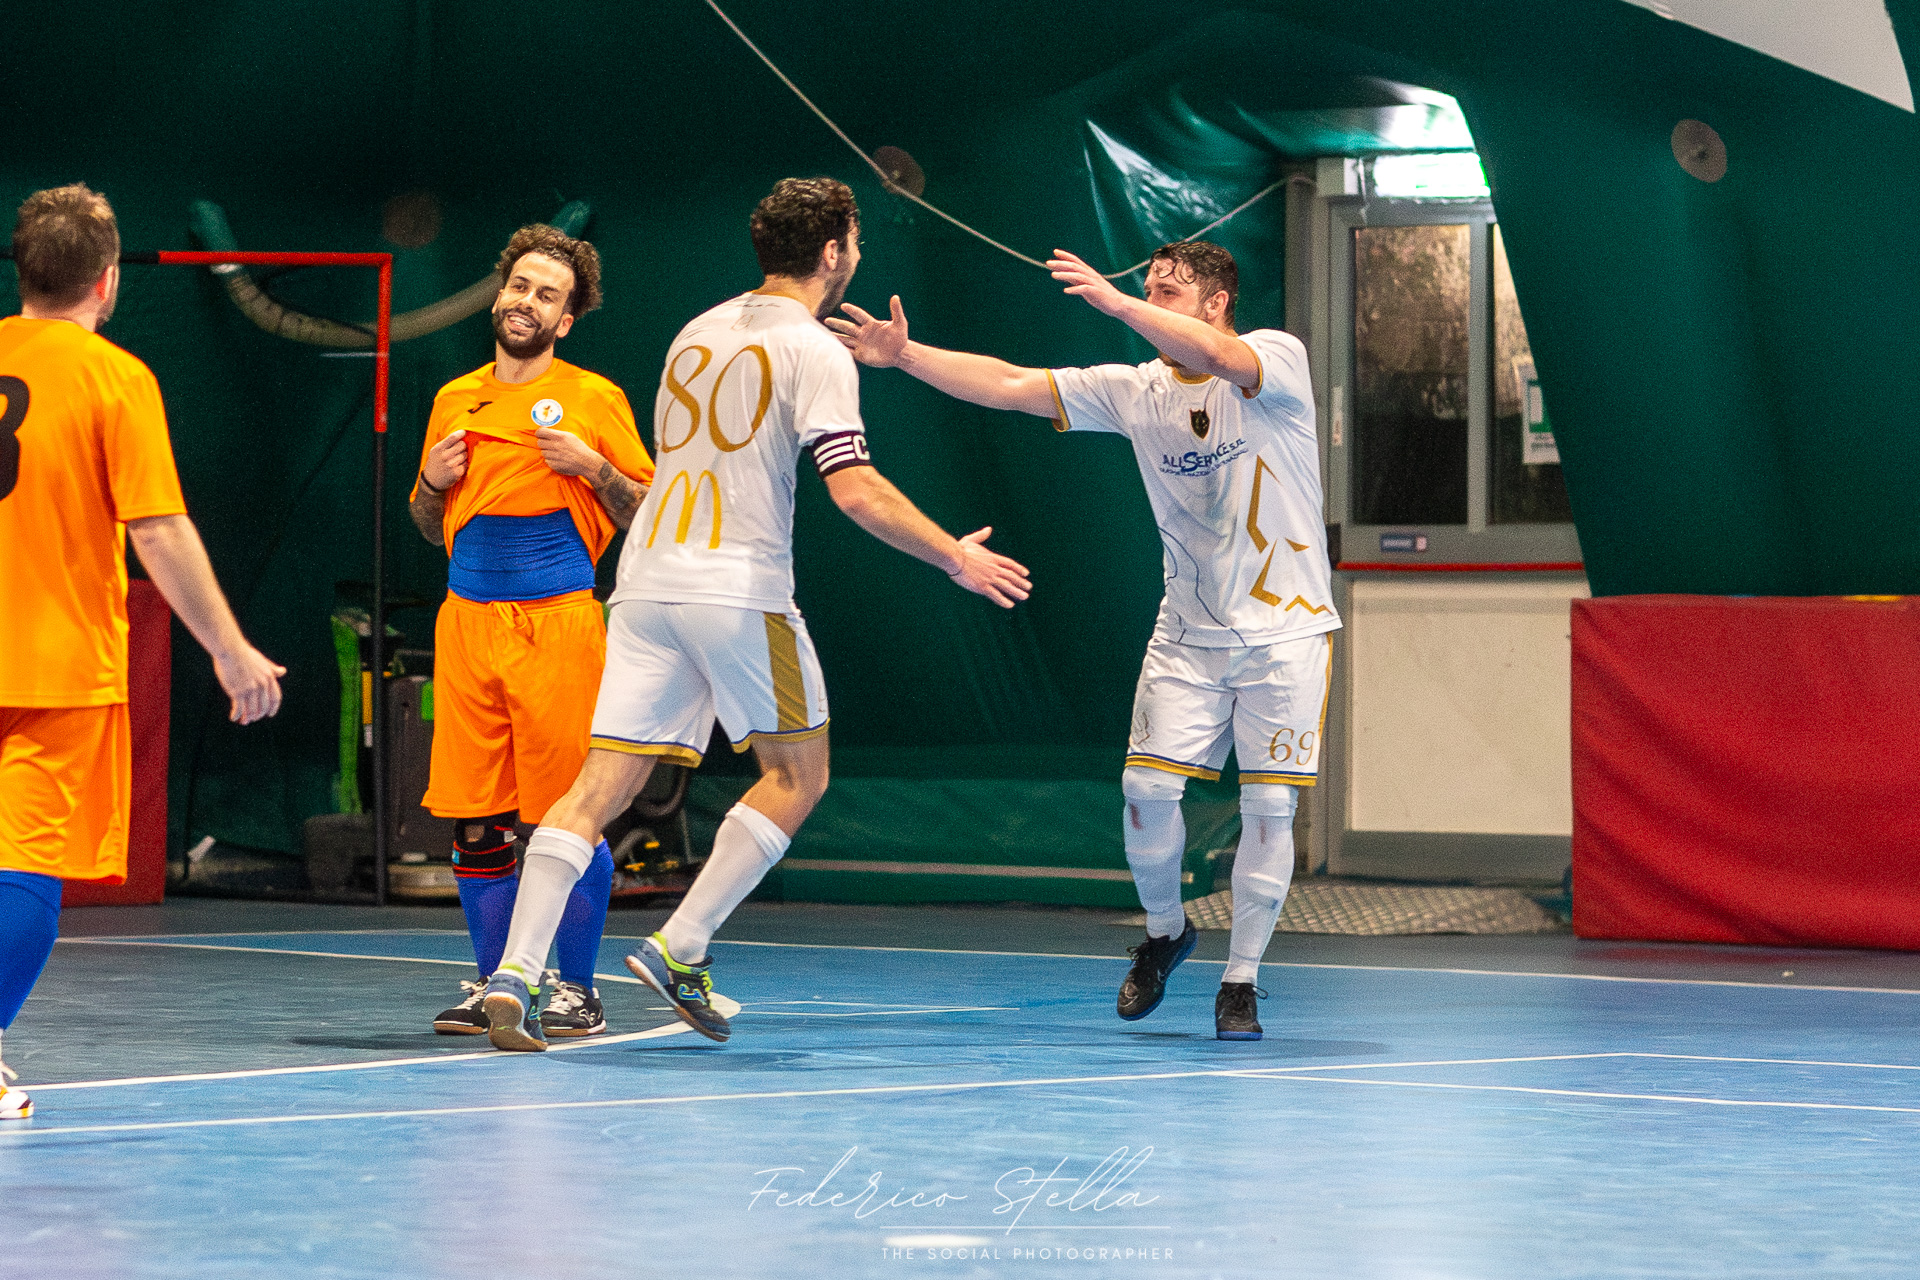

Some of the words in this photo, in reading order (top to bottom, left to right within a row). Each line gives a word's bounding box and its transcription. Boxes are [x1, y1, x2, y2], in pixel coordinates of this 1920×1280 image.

[662, 344, 773, 454] 80
[853, 434, 870, 461] C
[1269, 727, 1315, 766] 69
